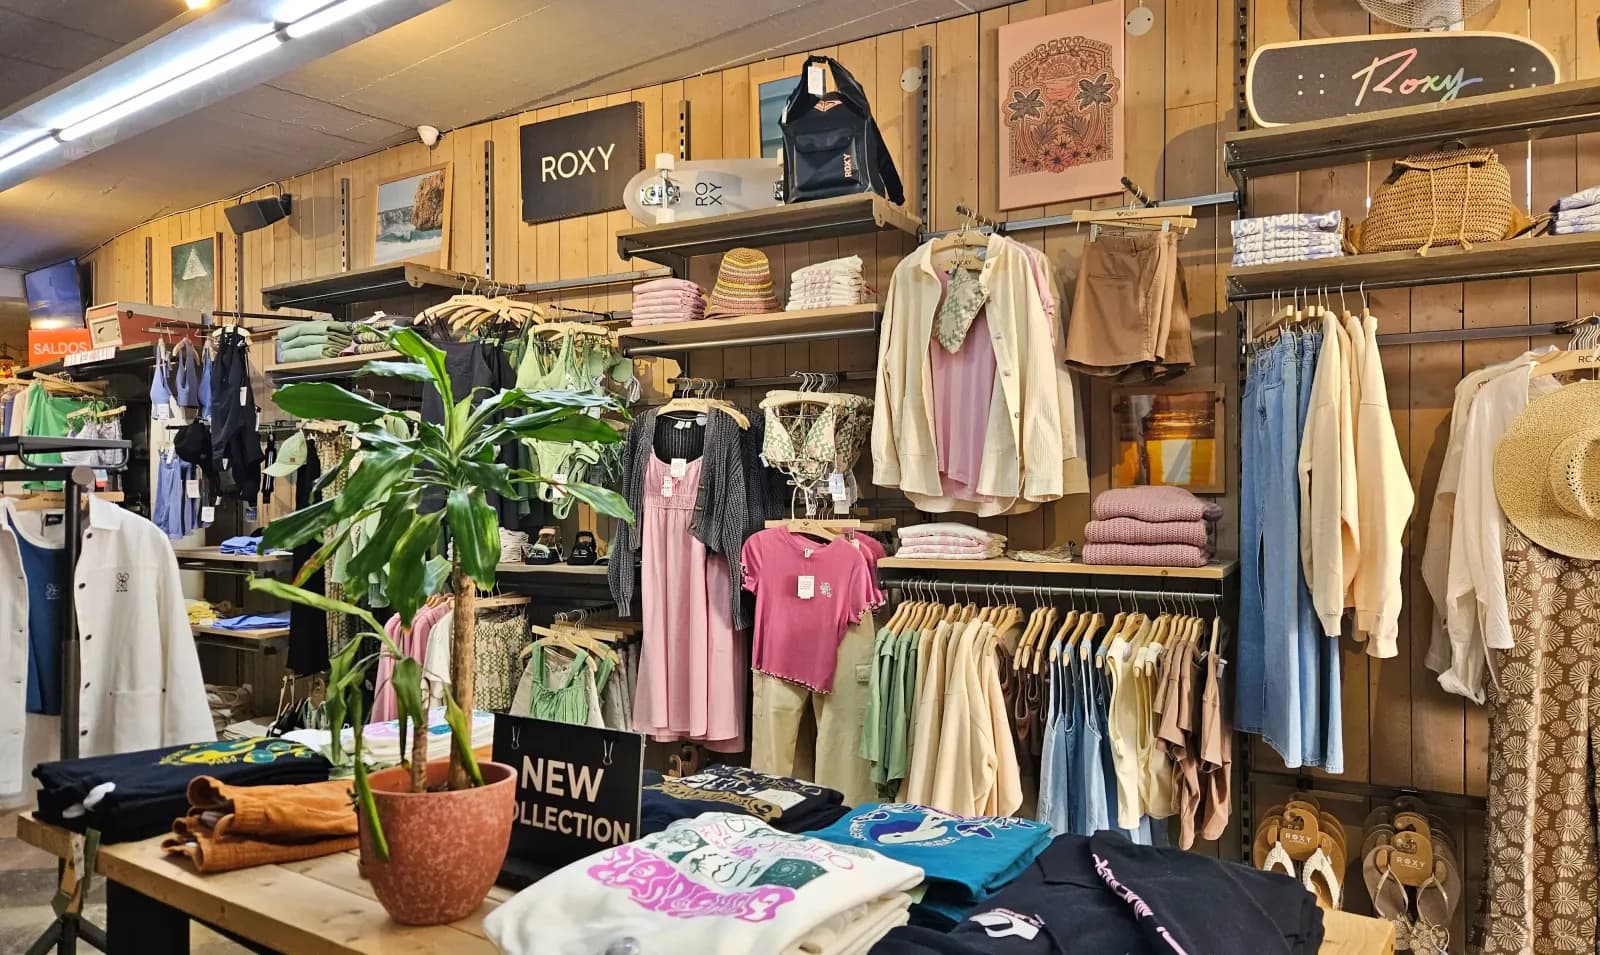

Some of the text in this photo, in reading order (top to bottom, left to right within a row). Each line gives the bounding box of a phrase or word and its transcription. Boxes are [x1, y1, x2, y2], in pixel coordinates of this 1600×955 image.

[1351, 48, 1483, 106] Roxy
[541, 143, 616, 183] ROXY
[843, 153, 852, 178] ROXY
[695, 182, 708, 206] RO
[709, 182, 722, 206] XY
[33, 341, 88, 356] SALDOS
[521, 755, 604, 803] NEW
[512, 800, 631, 846] LLECTION
[1285, 832, 1312, 843] ROXY
[1396, 856, 1424, 868] ROXY
